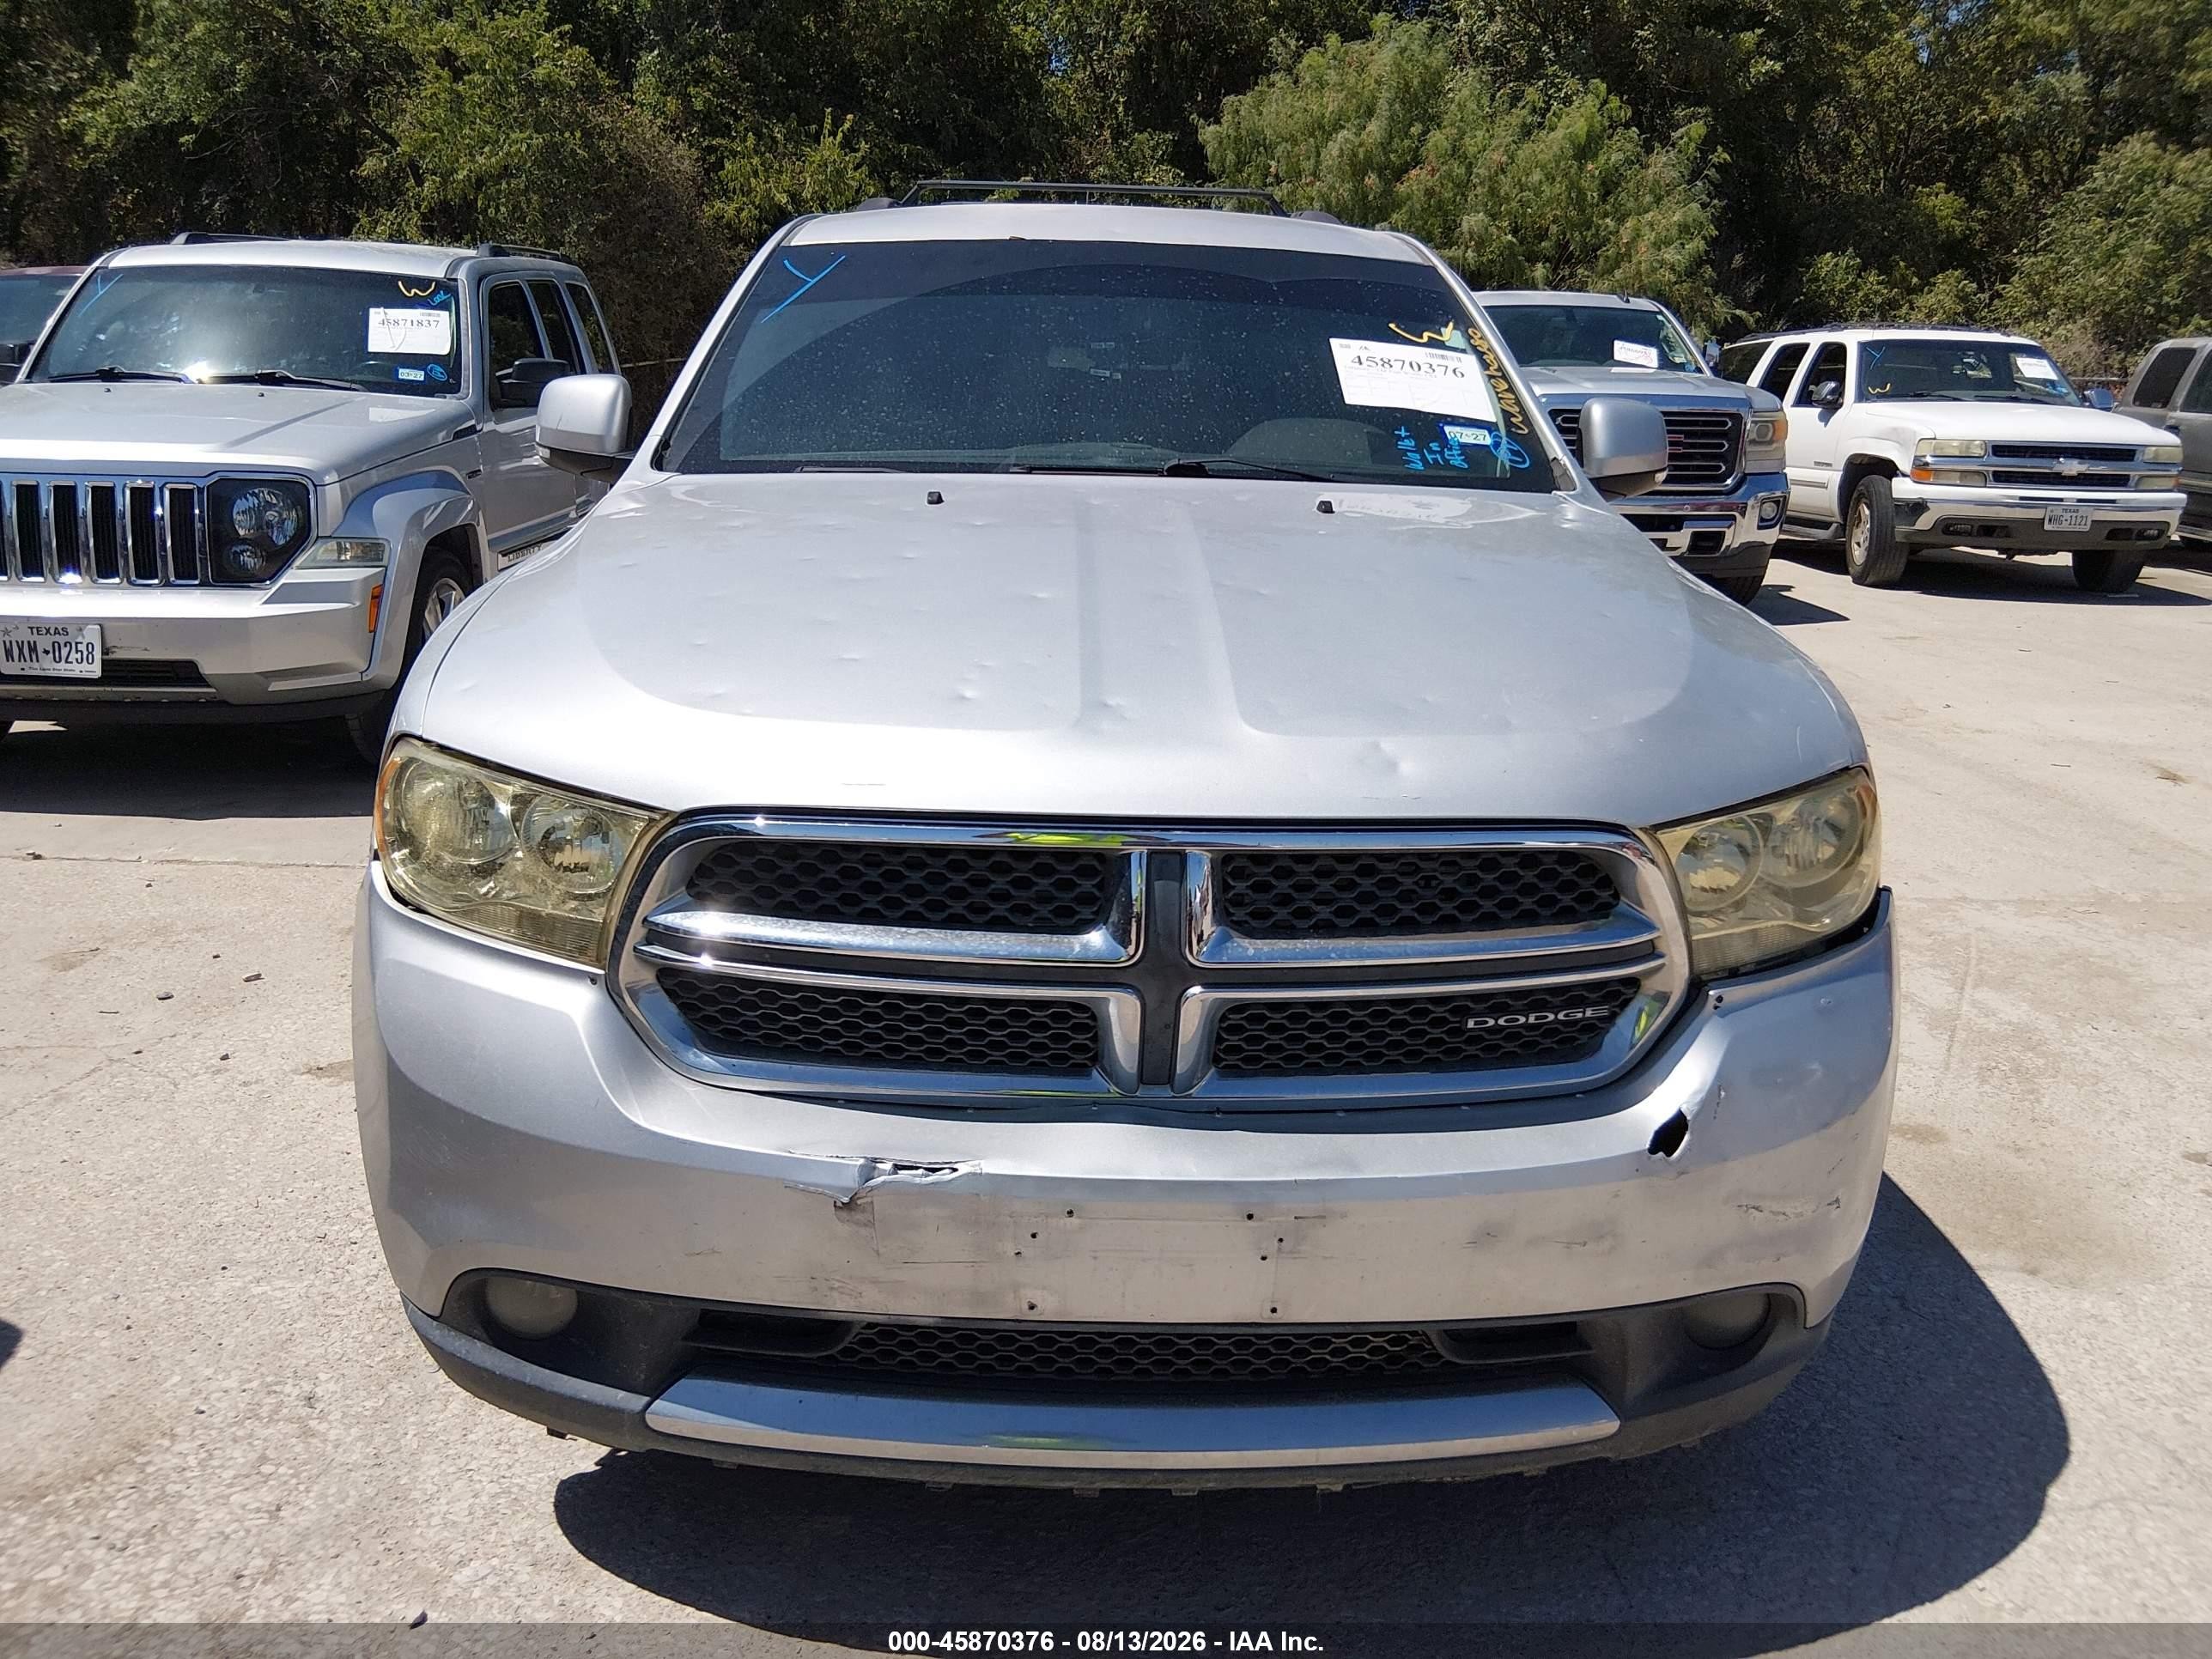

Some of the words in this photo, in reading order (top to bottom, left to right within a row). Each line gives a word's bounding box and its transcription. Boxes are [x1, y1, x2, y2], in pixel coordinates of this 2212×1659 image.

[762, 255, 846, 324] Y
[378, 319, 441, 328] 45871837
[1351, 355, 1466, 379] 45870376
[507, 543, 543, 562] LIBERTY
[27, 626, 70, 636] TEXAS
[1466, 1005, 1609, 1029] DODGE
